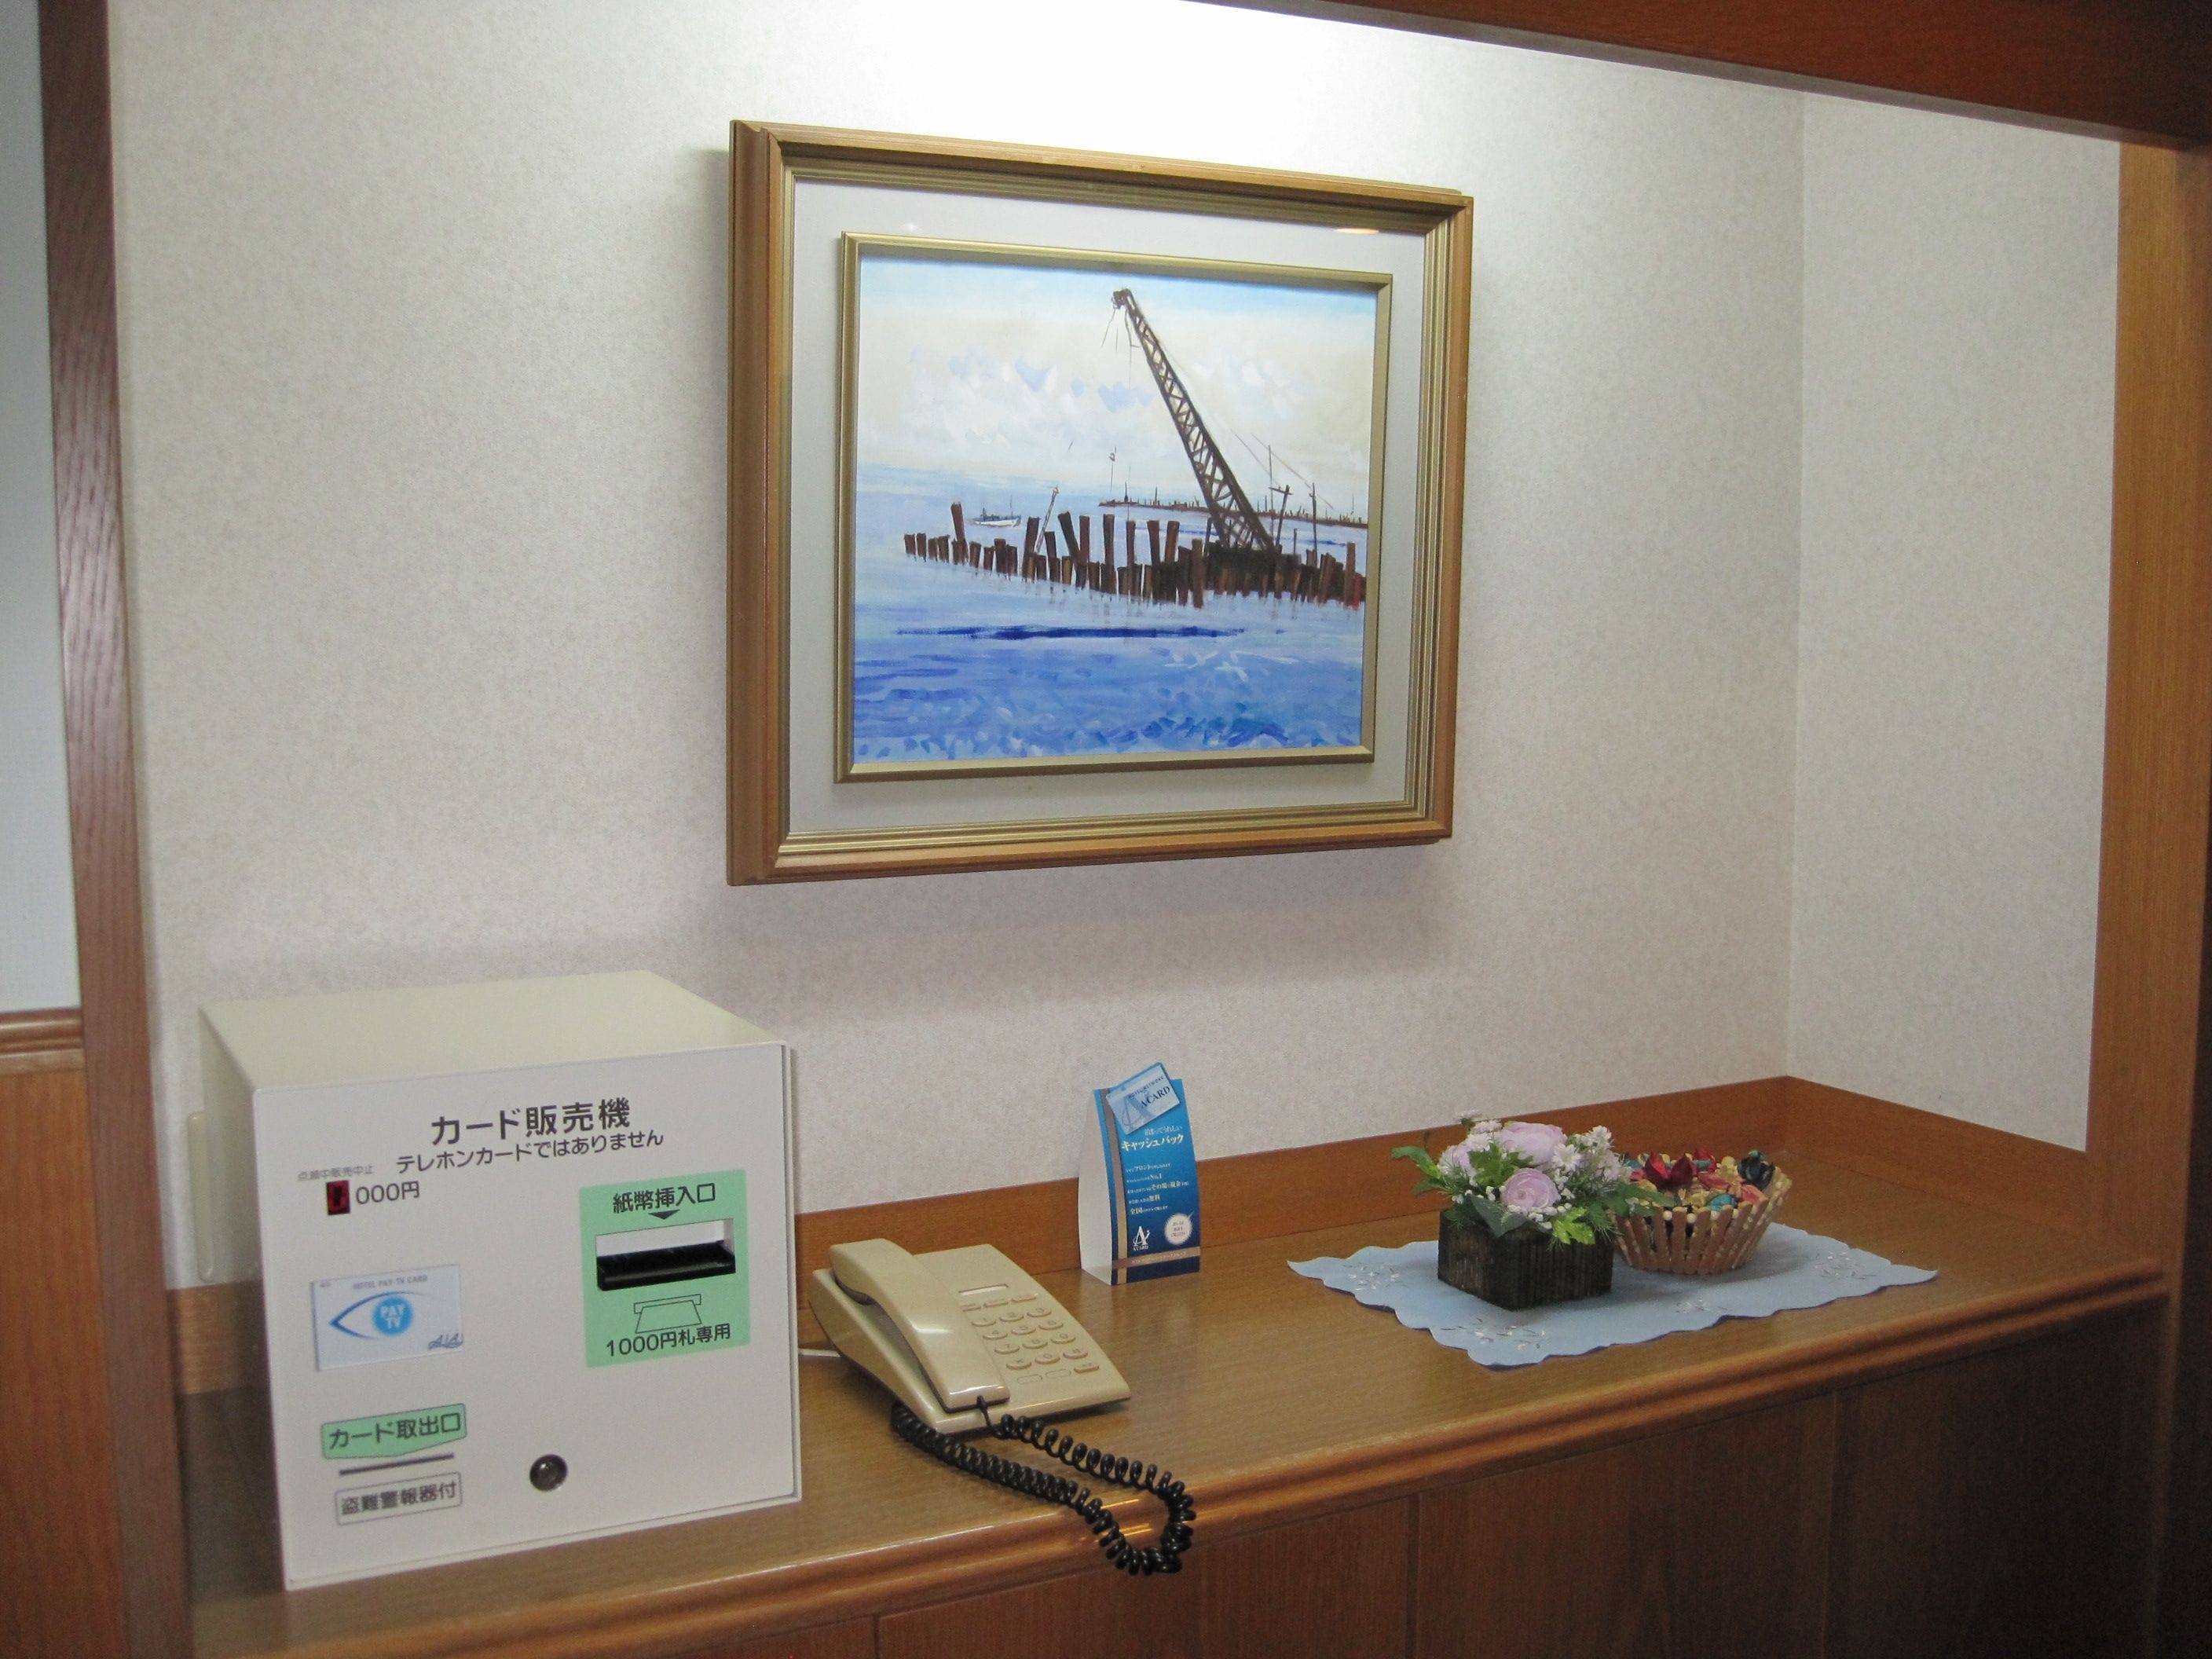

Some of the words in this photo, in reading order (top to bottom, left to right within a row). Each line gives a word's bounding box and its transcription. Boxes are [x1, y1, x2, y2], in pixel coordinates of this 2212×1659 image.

[431, 1097, 630, 1145] カード販売機
[397, 1130, 665, 1174] テレホンカードではありません
[1121, 1133, 1185, 1152] キャッシュバック
[612, 1182, 716, 1214] 紙幣挿入口
[606, 1323, 731, 1357] 1000円札専用
[329, 1412, 460, 1450] カード取出口
